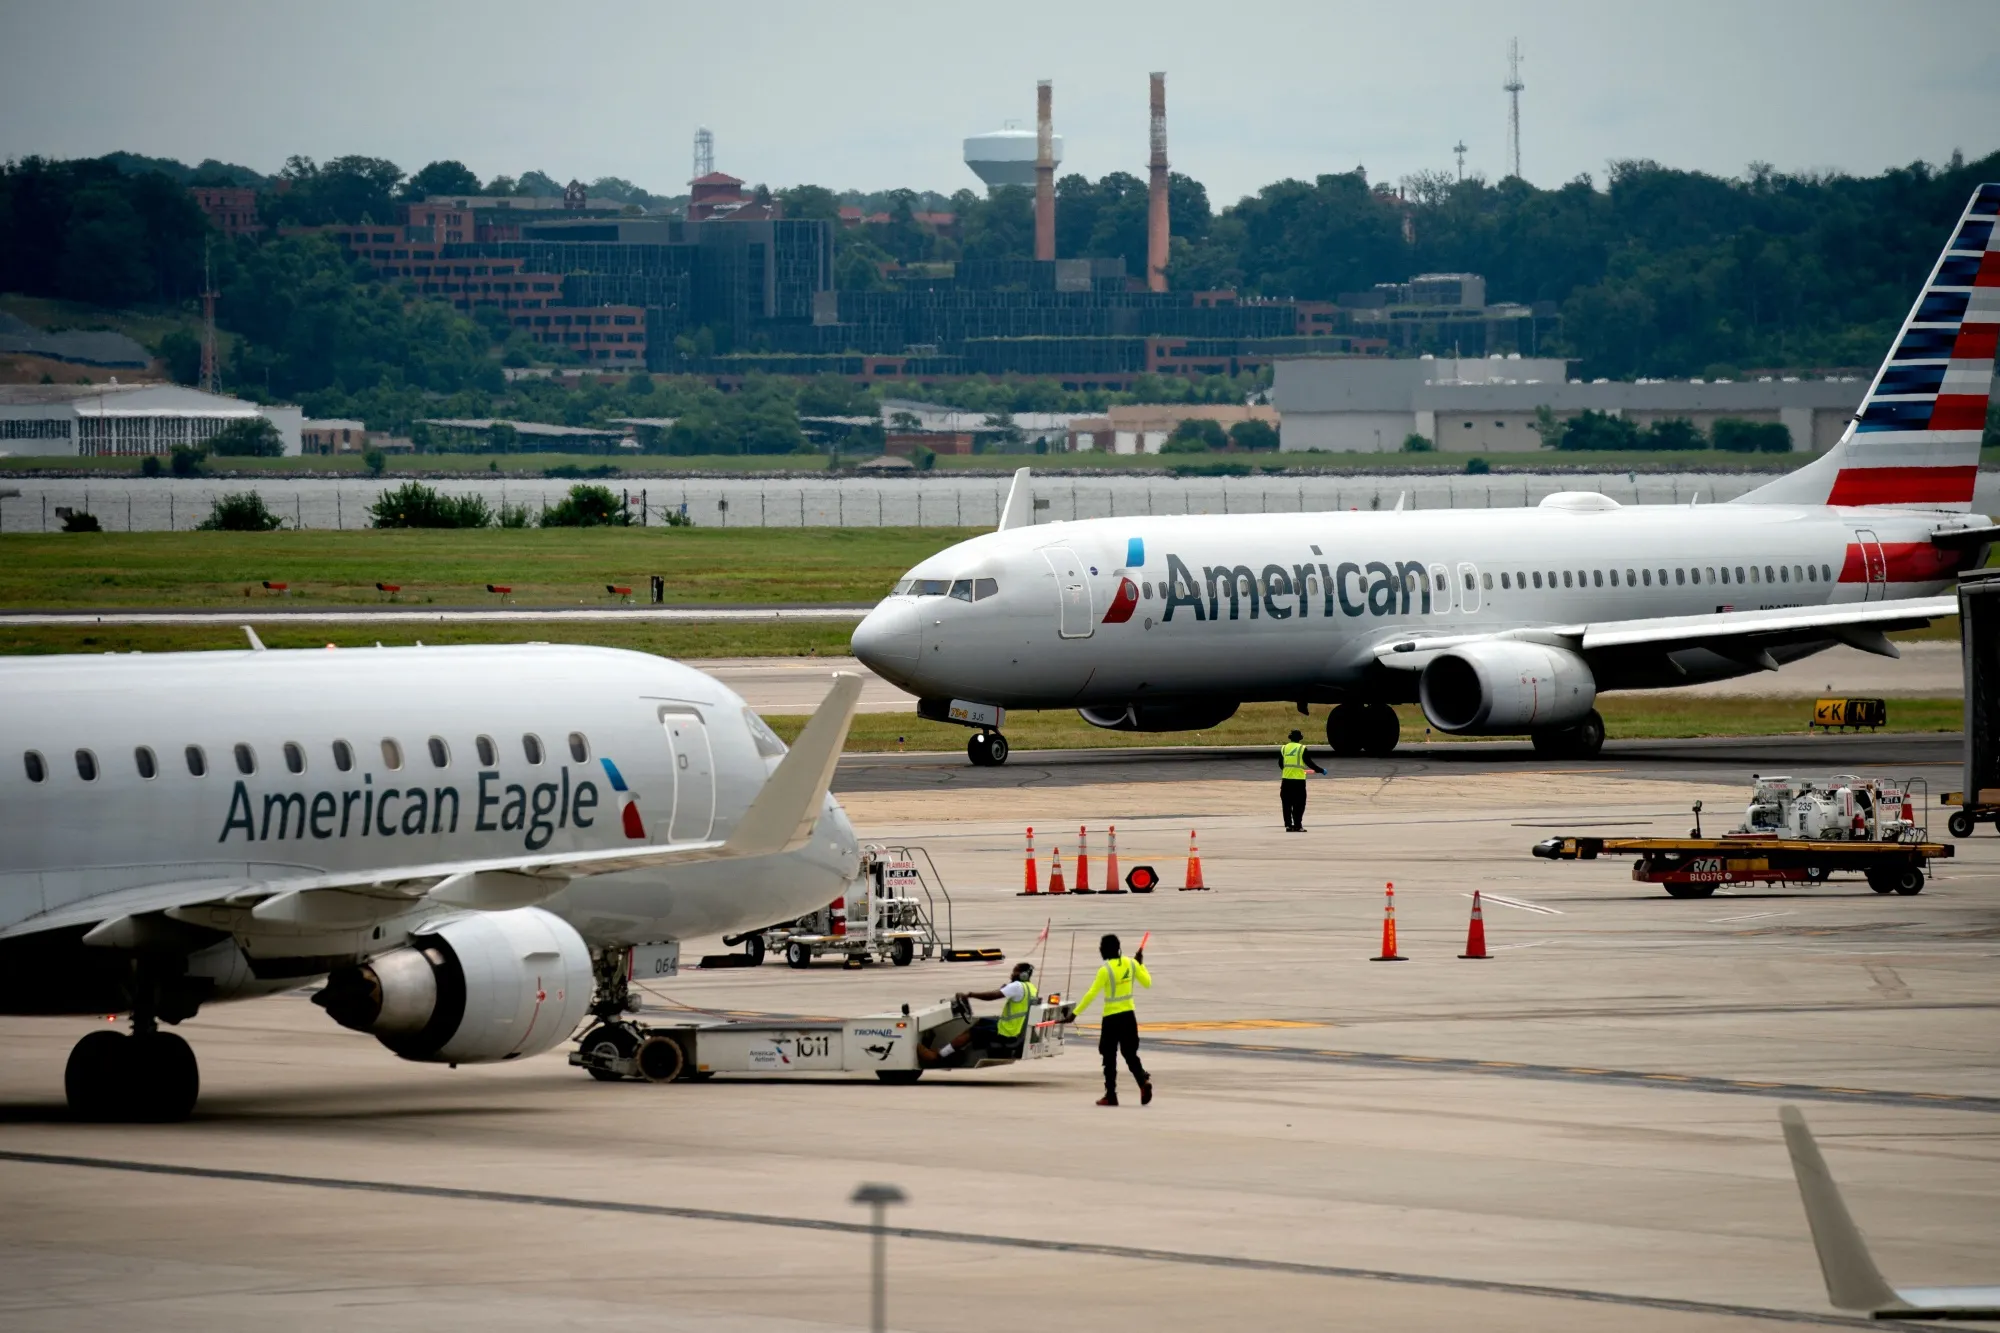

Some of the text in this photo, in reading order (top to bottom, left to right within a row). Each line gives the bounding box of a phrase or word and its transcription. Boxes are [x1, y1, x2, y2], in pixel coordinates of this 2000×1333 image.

[1162, 544, 1431, 622] American
[1832, 703, 1842, 721] K
[218, 766, 599, 850] American Eagle
[1798, 802, 1812, 812] 235
[887, 861, 915, 869] FLAMMABLE
[655, 957, 676, 974] 064
[854, 1029, 893, 1037] TRONAIR
[795, 1036, 829, 1058] 1011
